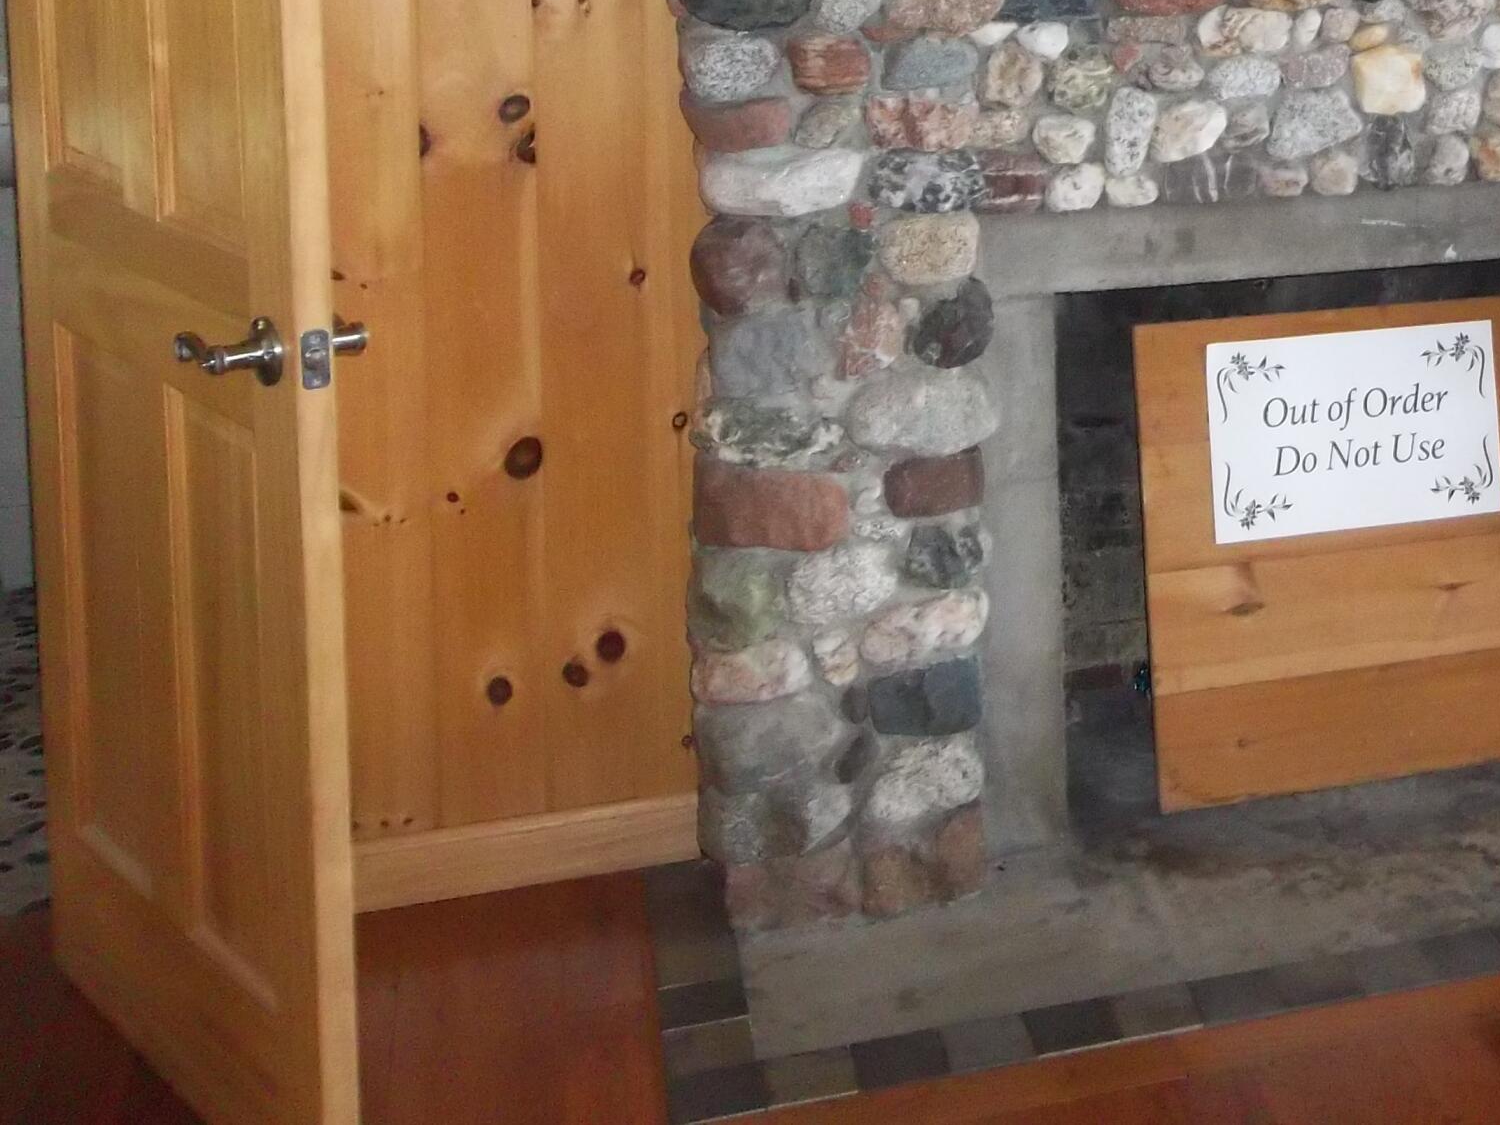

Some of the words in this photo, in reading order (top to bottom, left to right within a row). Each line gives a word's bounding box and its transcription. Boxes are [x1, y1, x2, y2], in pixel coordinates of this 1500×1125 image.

[1263, 397, 1320, 428] Out
[1327, 387, 1358, 431] of
[1362, 382, 1449, 418] Order
[1272, 445, 1318, 476] Do
[1326, 438, 1383, 471] Not
[1391, 432, 1446, 463] Use
